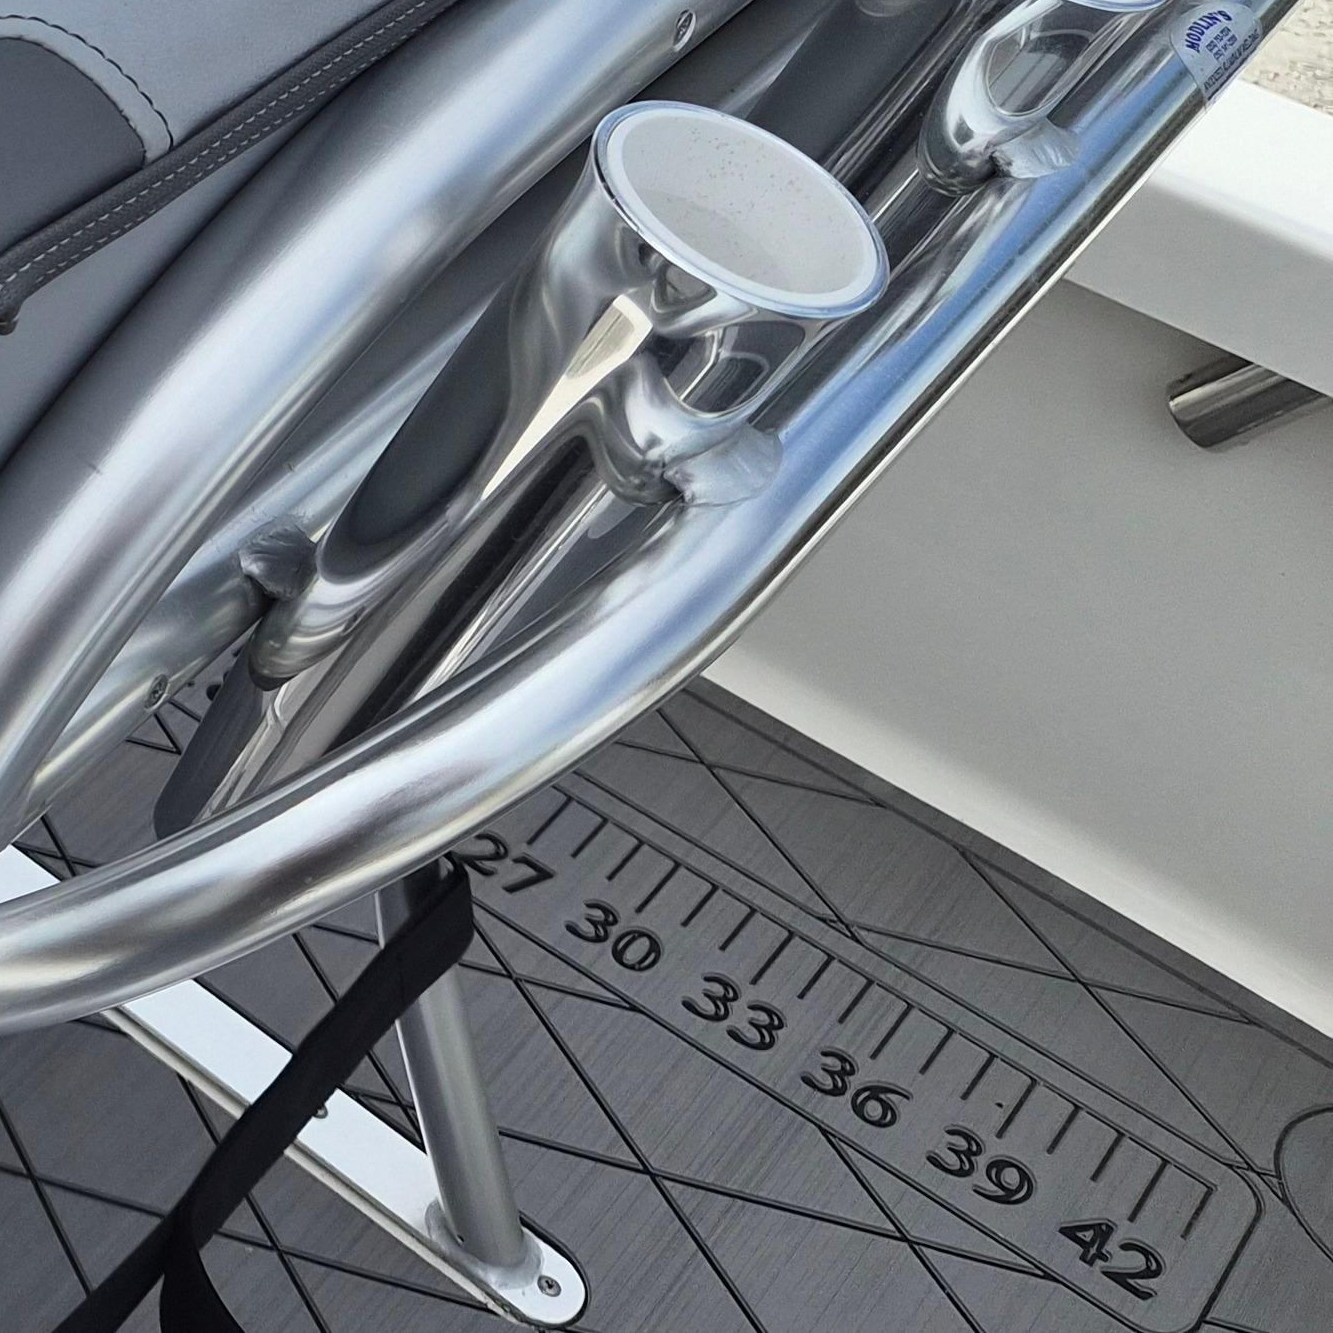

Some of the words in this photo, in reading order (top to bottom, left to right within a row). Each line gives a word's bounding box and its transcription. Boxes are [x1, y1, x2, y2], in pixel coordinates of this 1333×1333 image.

[1185, 10, 1233, 54] MODLIN'S
[446, 832, 556, 894] 27
[564, 898, 664, 972] 30
[681, 972, 787, 1051] 33
[800, 1047, 913, 1128] 36
[925, 1125, 1037, 1205] 39
[1058, 1218, 1166, 1301] 42
